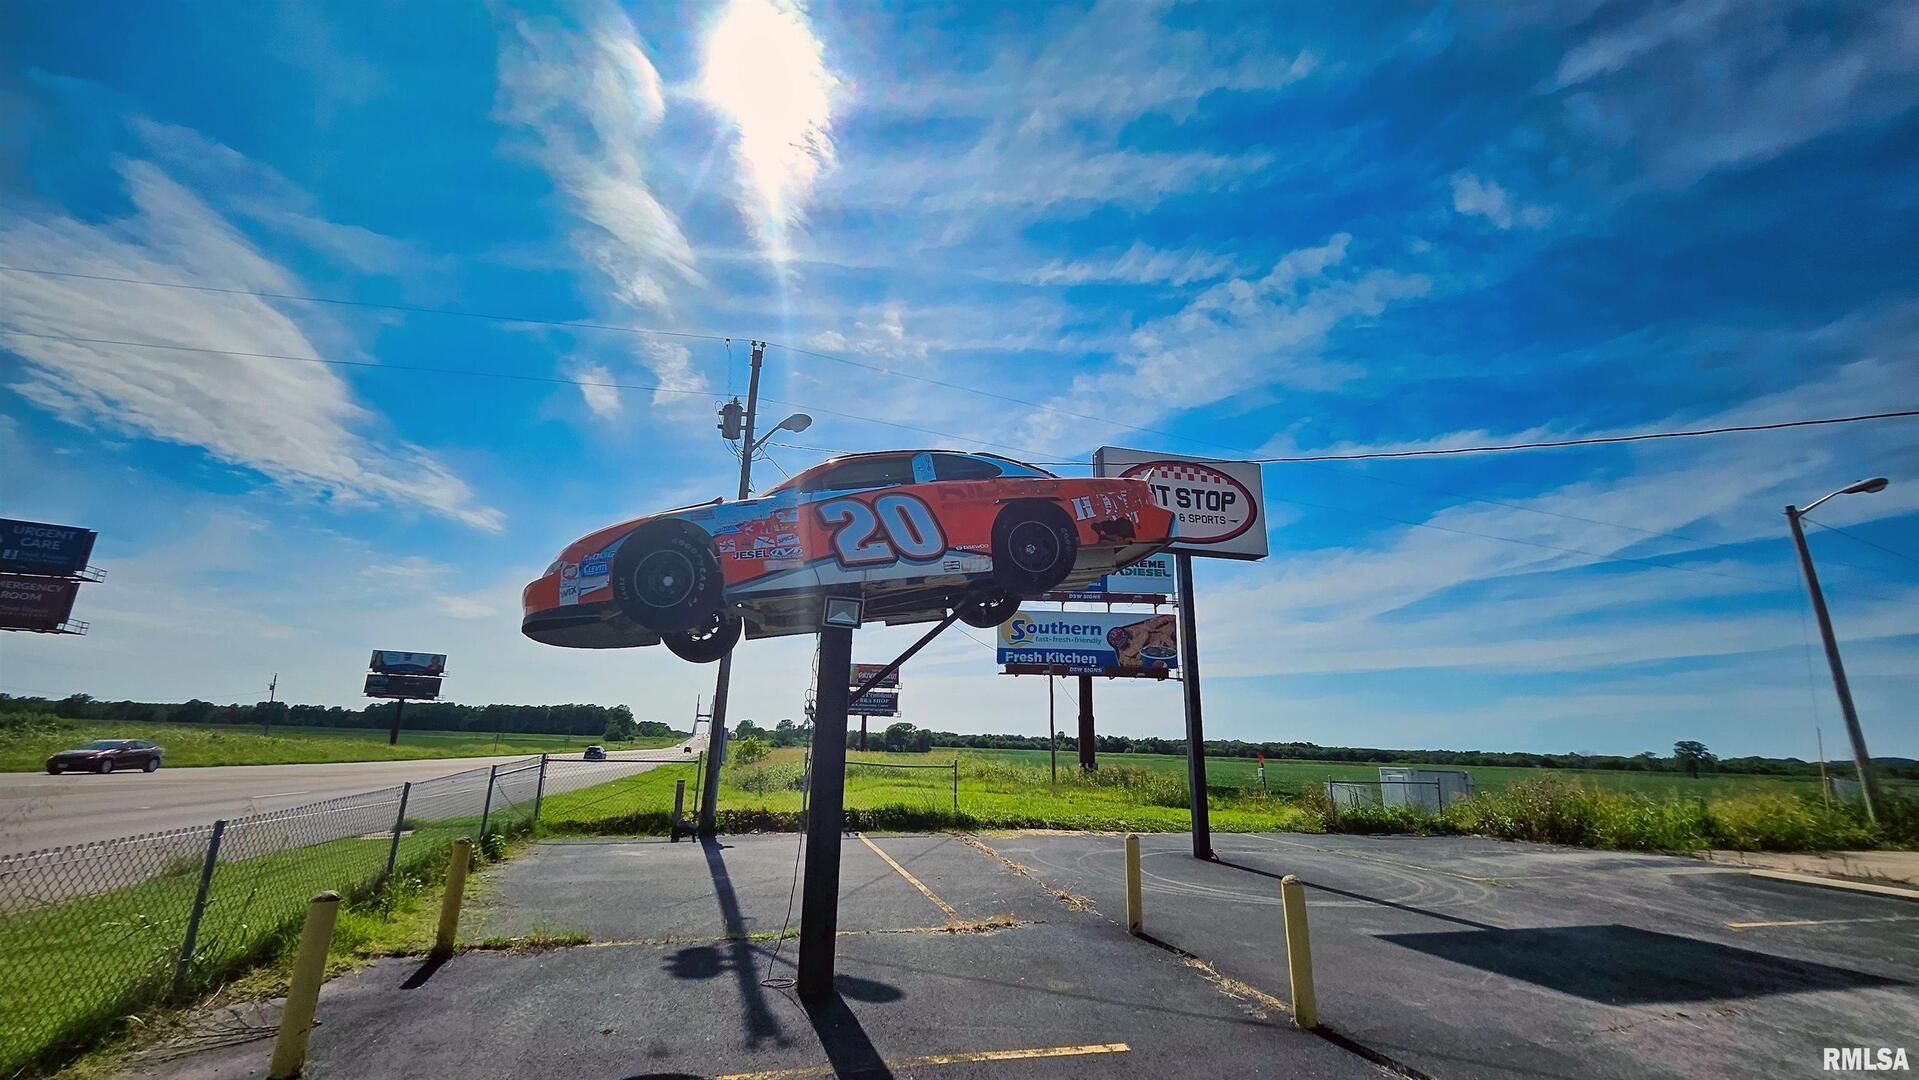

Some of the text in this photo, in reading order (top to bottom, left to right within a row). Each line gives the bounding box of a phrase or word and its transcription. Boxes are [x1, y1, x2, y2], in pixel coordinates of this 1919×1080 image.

[1150, 484, 1236, 513] IT STOP
[1179, 513, 1226, 525] & SPORTS
[14, 525, 78, 539] URGENT
[815, 493, 948, 568] 20
[20, 537, 62, 550] CARE
[733, 549, 769, 559] JESEL
[0, 590, 42, 601] ROOM
[560, 587, 577, 597] WIX
[1010, 619, 1102, 640] Southern
[1005, 651, 1097, 665] Fresh Kitchen
